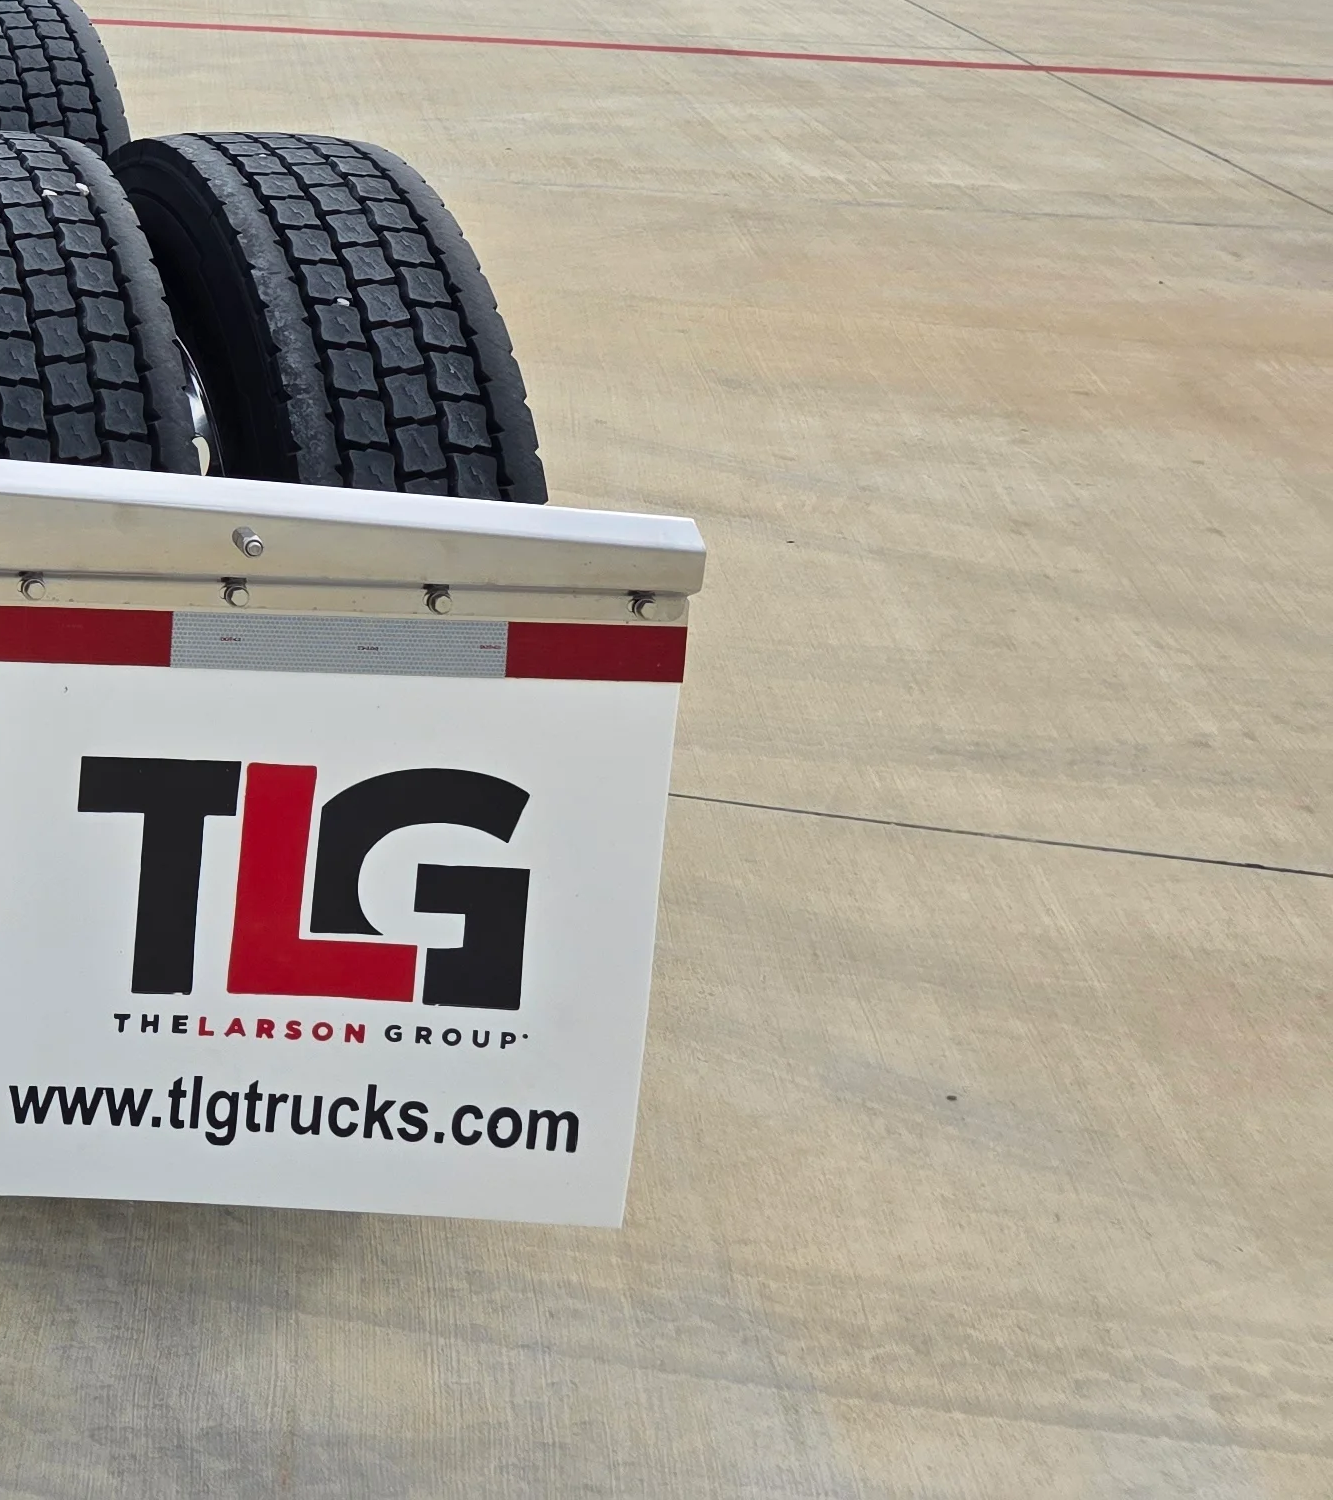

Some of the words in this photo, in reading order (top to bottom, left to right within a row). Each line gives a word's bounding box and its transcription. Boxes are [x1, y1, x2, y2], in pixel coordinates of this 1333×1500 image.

[78, 756, 530, 1011] TLG
[385, 1025, 517, 1050] GROUP
[9, 1076, 579, 1153] www.tlgtrucks.com
